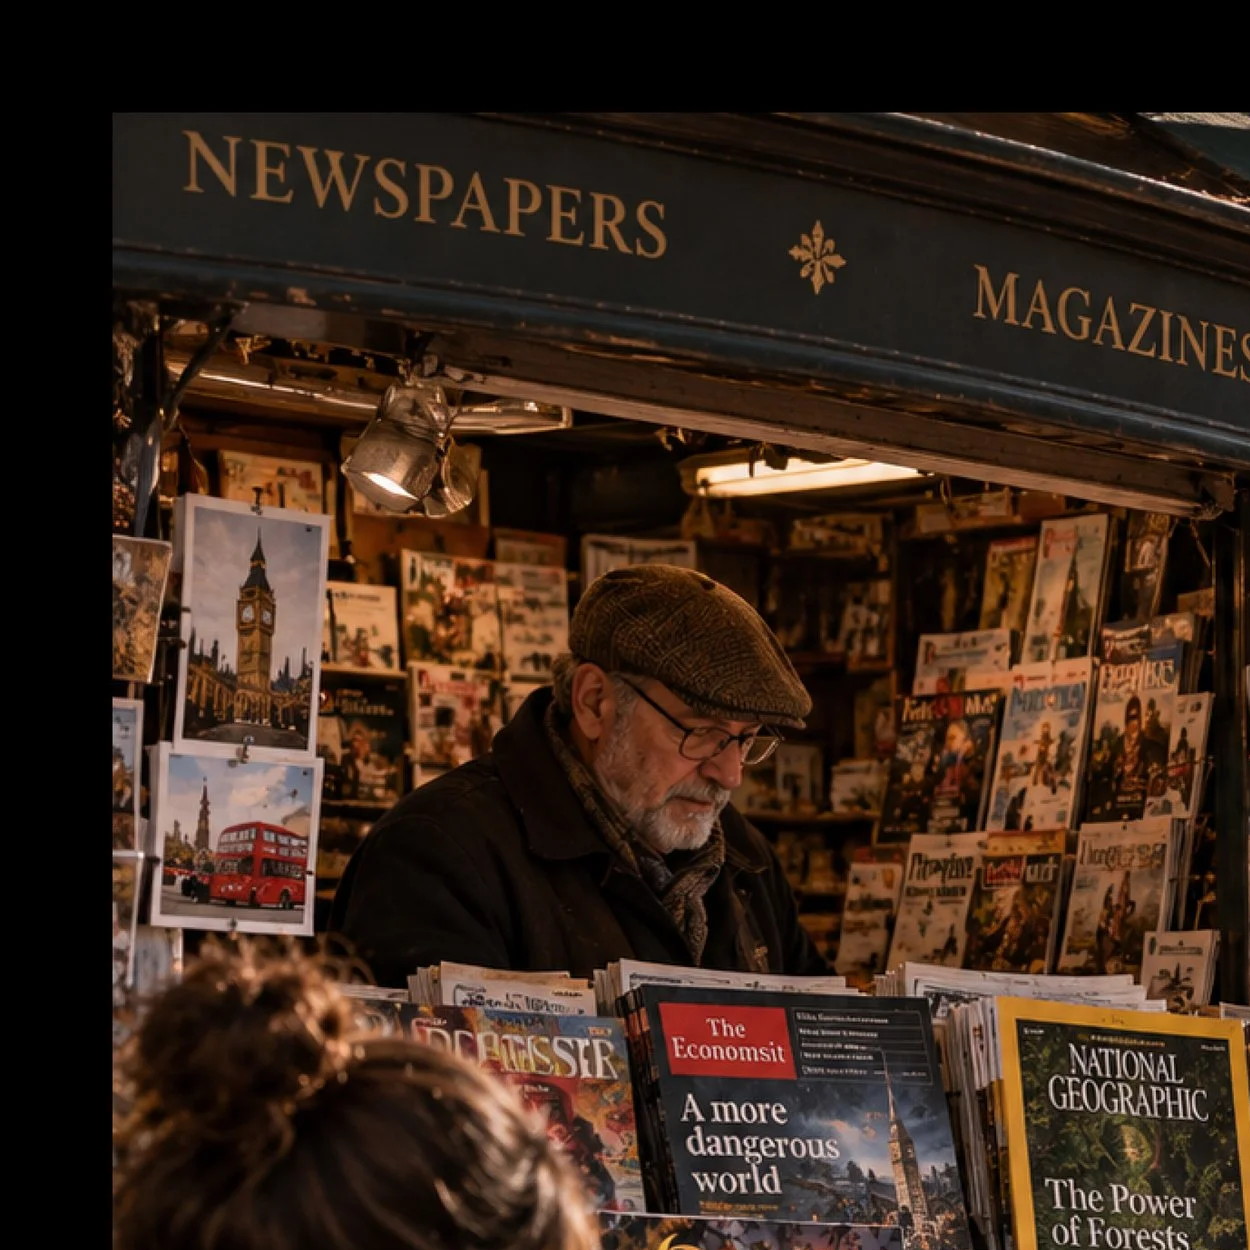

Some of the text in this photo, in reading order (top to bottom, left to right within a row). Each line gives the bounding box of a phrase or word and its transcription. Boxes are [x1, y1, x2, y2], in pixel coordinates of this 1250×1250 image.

[181, 130, 669, 260] NEWSPAPERS
[705, 1017, 746, 1040] The
[671, 1036, 786, 1066] Economsit
[1068, 1043, 1183, 1084] NATIONAL
[681, 1093, 788, 1126] A more
[1048, 1075, 1209, 1122] GEOGRAPHIC
[686, 1128, 840, 1168] dangerous
[692, 1164, 783, 1195] world
[1045, 1178, 1197, 1219] The Power
[1052, 1219, 1080, 1247] of
